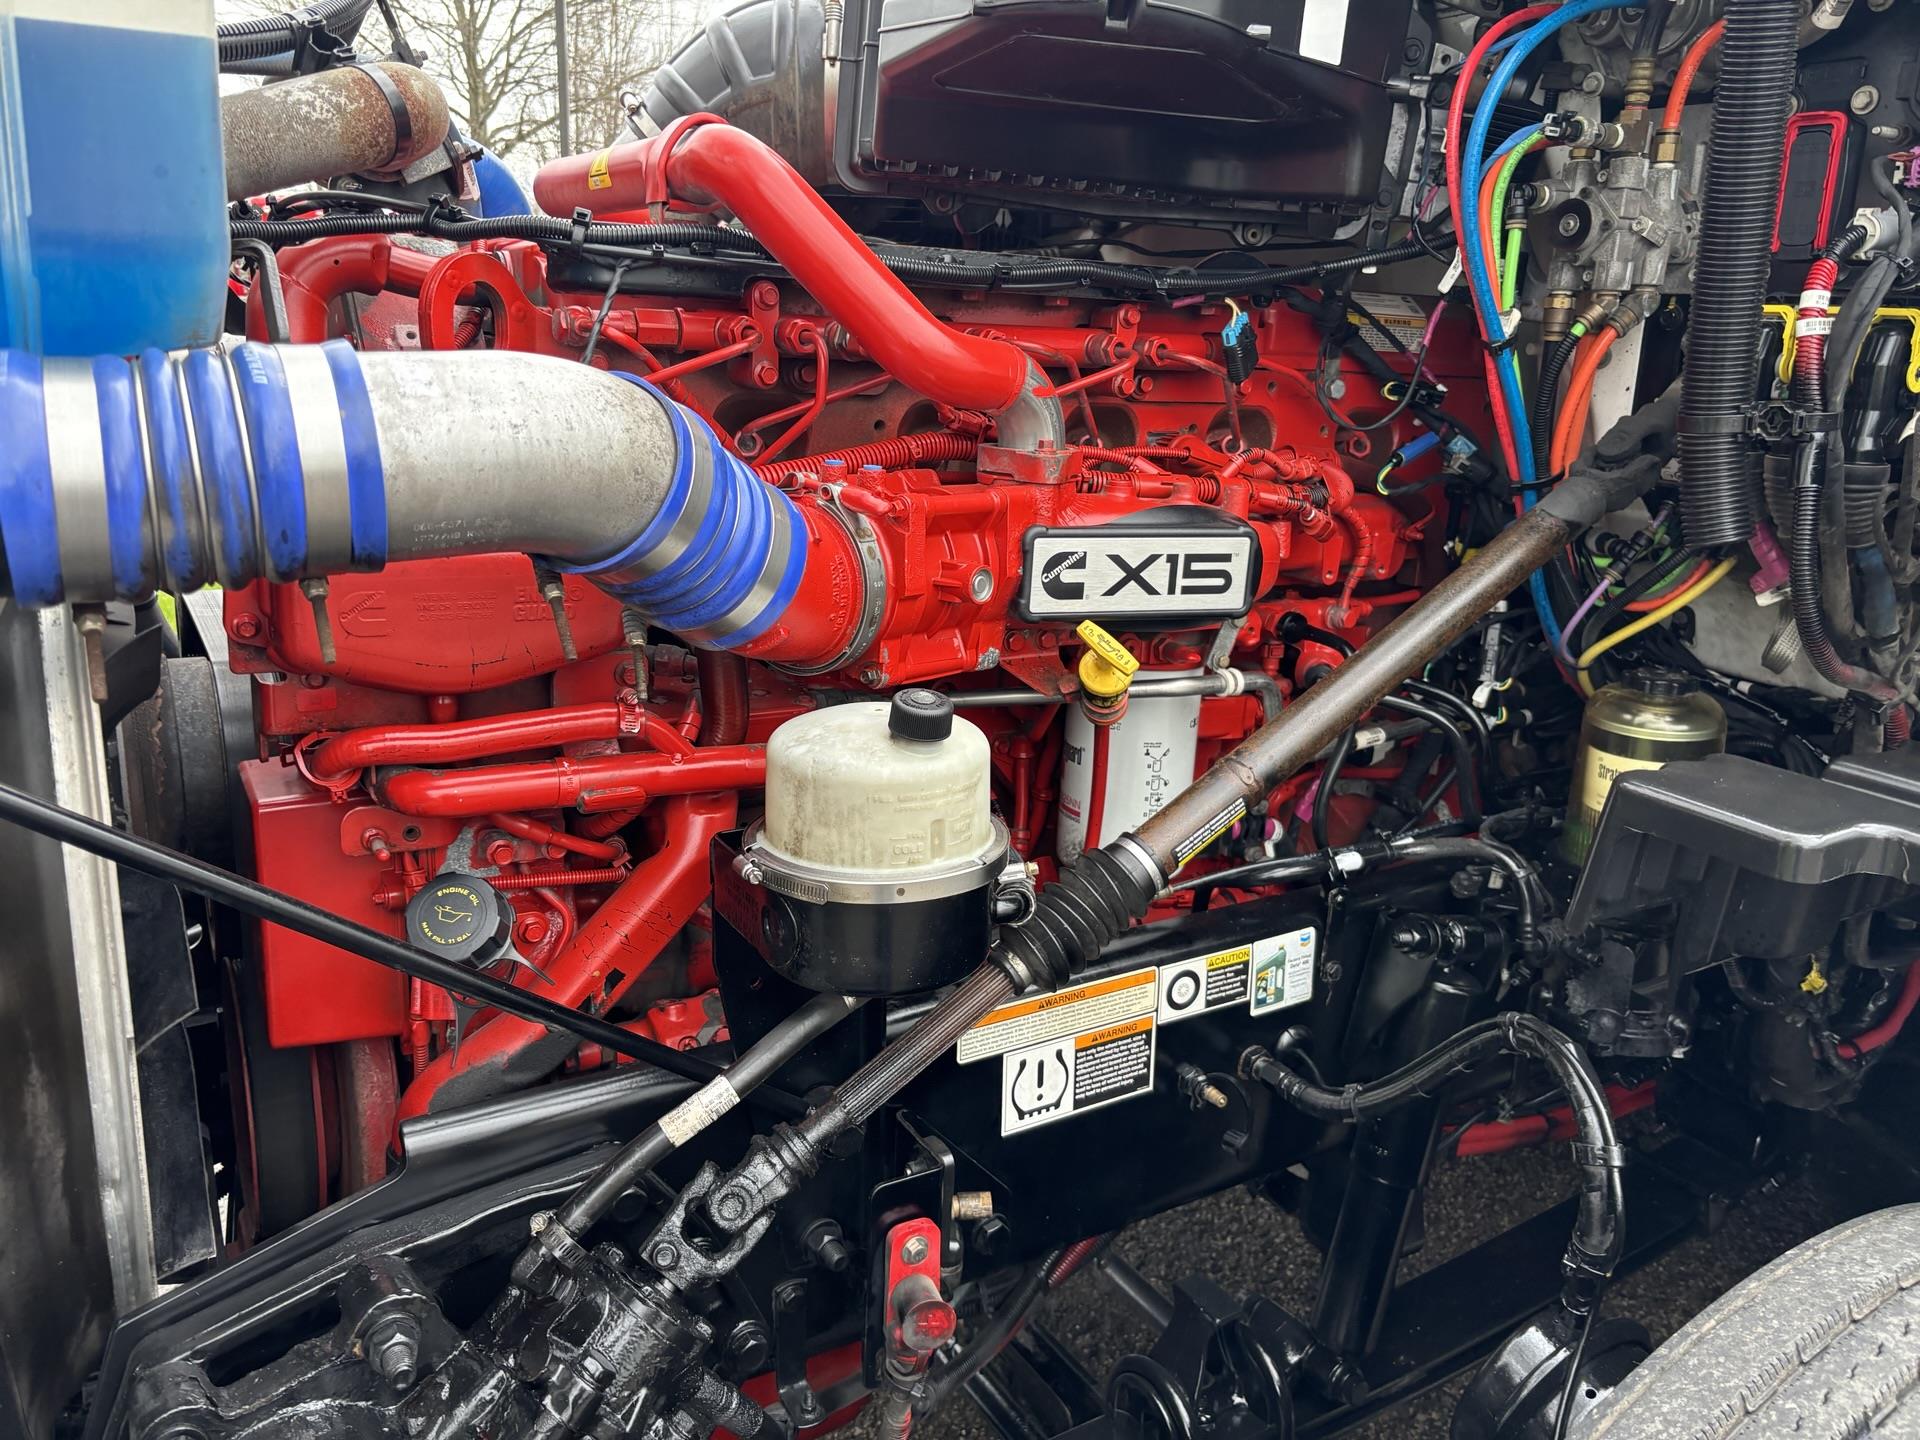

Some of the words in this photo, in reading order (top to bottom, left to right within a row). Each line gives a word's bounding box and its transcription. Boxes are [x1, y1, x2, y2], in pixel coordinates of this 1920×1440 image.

[1041, 550, 1085, 583] Cummins
[1100, 553, 1233, 596] X15
[437, 887, 470, 897] ENGINE
[469, 894, 480, 906] OIL
[421, 921, 432, 937] MAX
[432, 935, 446, 944] FILL
[456, 932, 472, 942] GAL
[1215, 952, 1250, 964] CAUTION
[1044, 990, 1086, 1007] WARNING
[1099, 1023, 1137, 1040] WARNING
